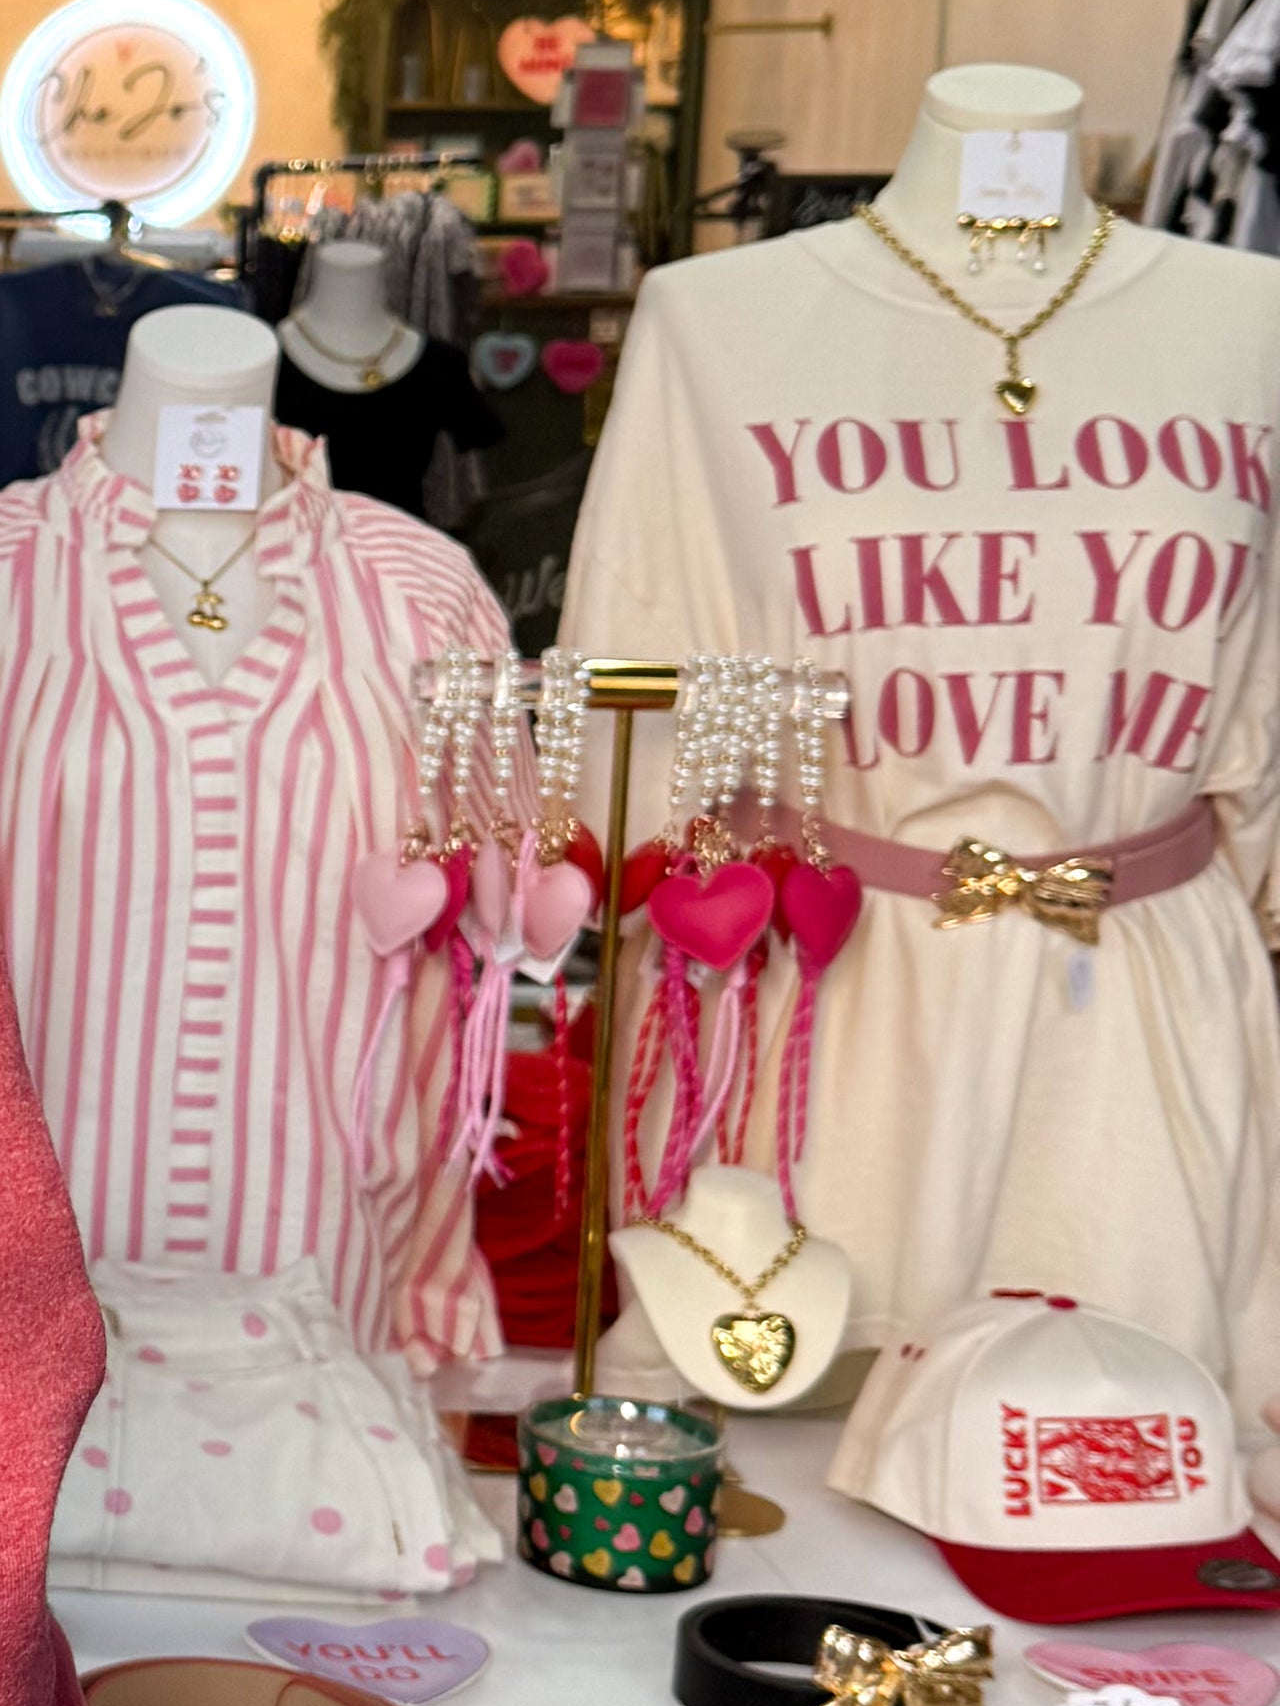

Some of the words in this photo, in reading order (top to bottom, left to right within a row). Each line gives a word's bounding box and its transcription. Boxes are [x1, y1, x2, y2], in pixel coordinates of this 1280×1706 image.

[745, 418, 959, 509] YOU
[997, 414, 1274, 513] LOOK
[789, 531, 1036, 638] LIKE
[839, 667, 1065, 771] LOVE
[1094, 669, 1212, 774] ME
[1000, 1401, 1033, 1518] LUCKY
[1176, 1416, 1208, 1493] YOU
[286, 1640, 462, 1663] YOU'LL
[348, 1664, 420, 1681] DO
[1079, 1667, 1236, 1684] SWIPE
